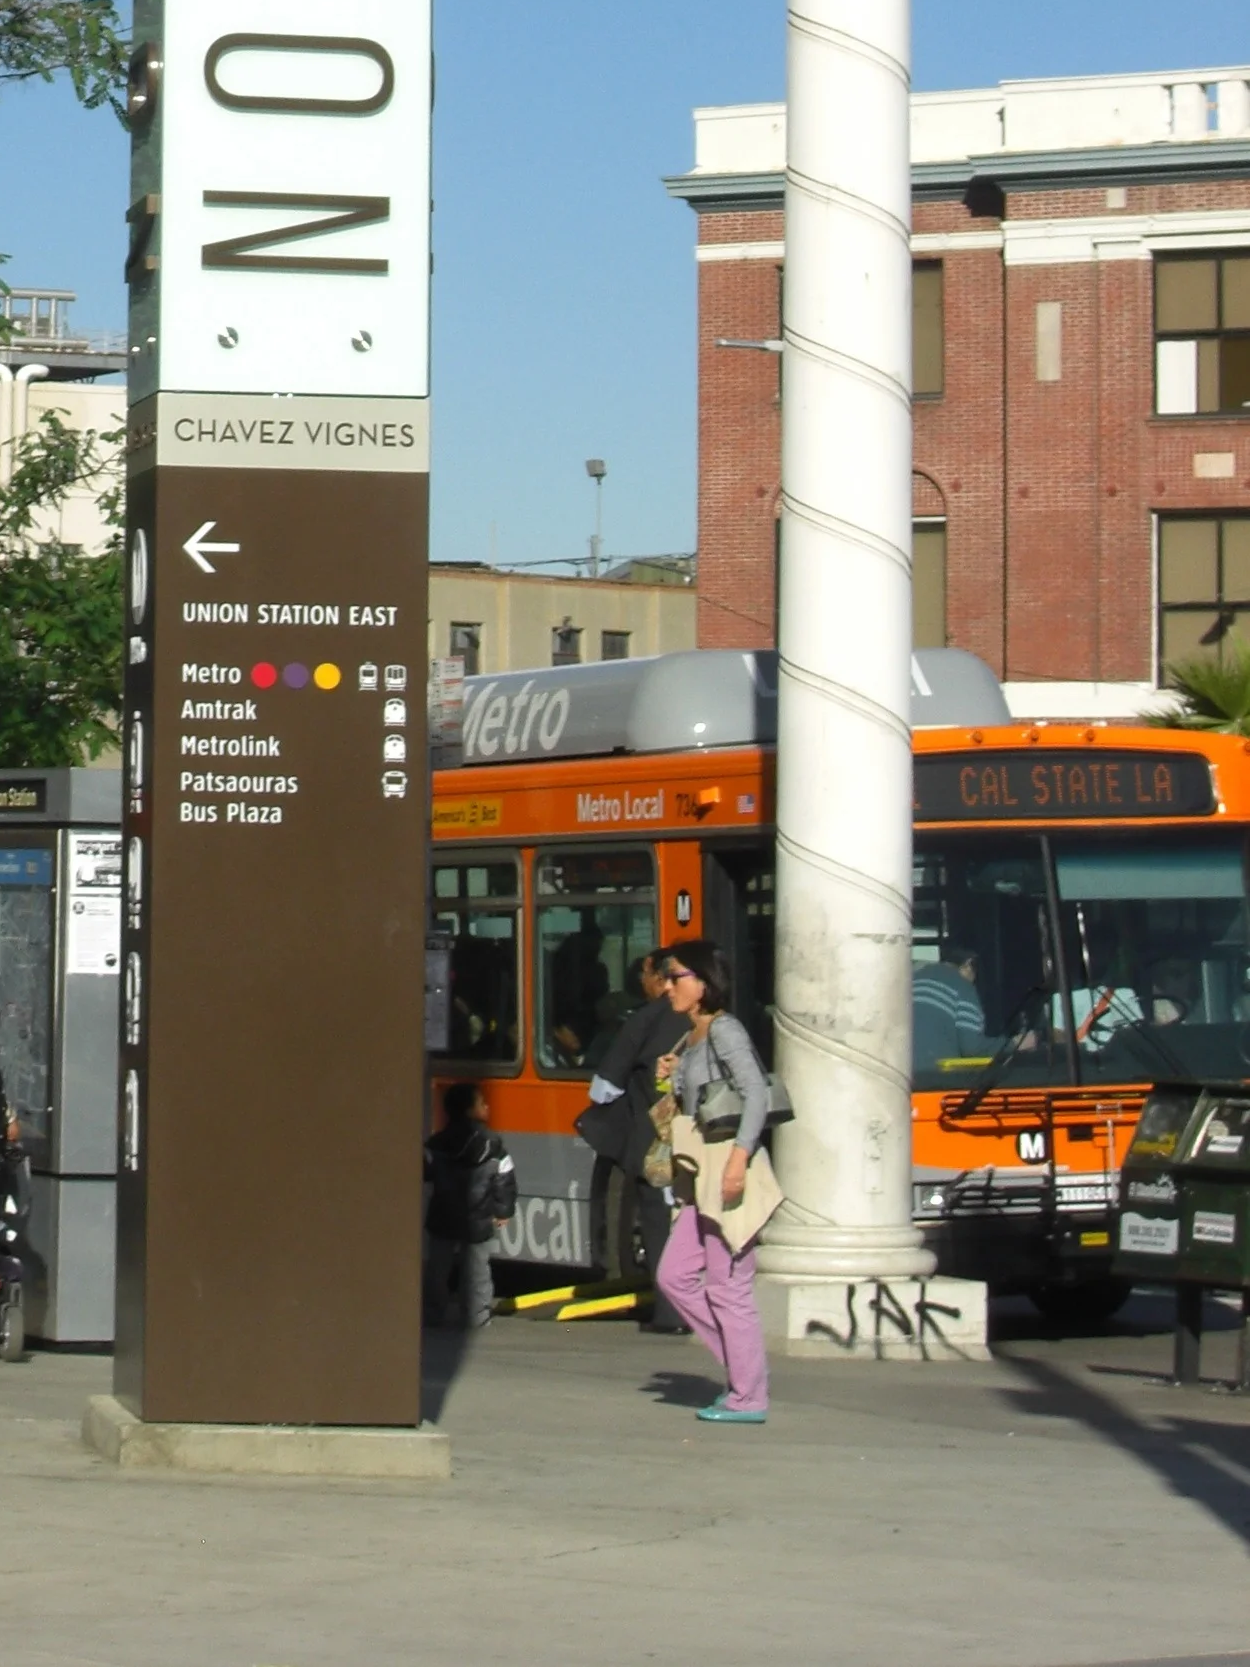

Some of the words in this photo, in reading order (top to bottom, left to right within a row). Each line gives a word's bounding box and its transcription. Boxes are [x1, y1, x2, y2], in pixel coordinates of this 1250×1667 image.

[173, 417, 294, 445] CHAVEZ
[304, 421, 415, 448] VIGNES
[182, 602, 249, 624] UNION
[257, 604, 340, 625] STATION
[349, 606, 398, 626] EAST
[181, 662, 242, 684] Metro
[180, 699, 258, 720] Amtrak
[462, 680, 570, 757] Metro
[180, 735, 281, 757] Metrolink
[179, 771, 299, 794] Patsaouras
[959, 766, 1019, 806] CAL
[1030, 764, 1123, 804] STATE
[1134, 763, 1173, 803] LA
[179, 802, 218, 823] Bus
[226, 802, 283, 824] Plaza
[577, 792, 621, 823] Metro
[623, 788, 665, 821] Local
[1019, 1132, 1045, 1160] M
